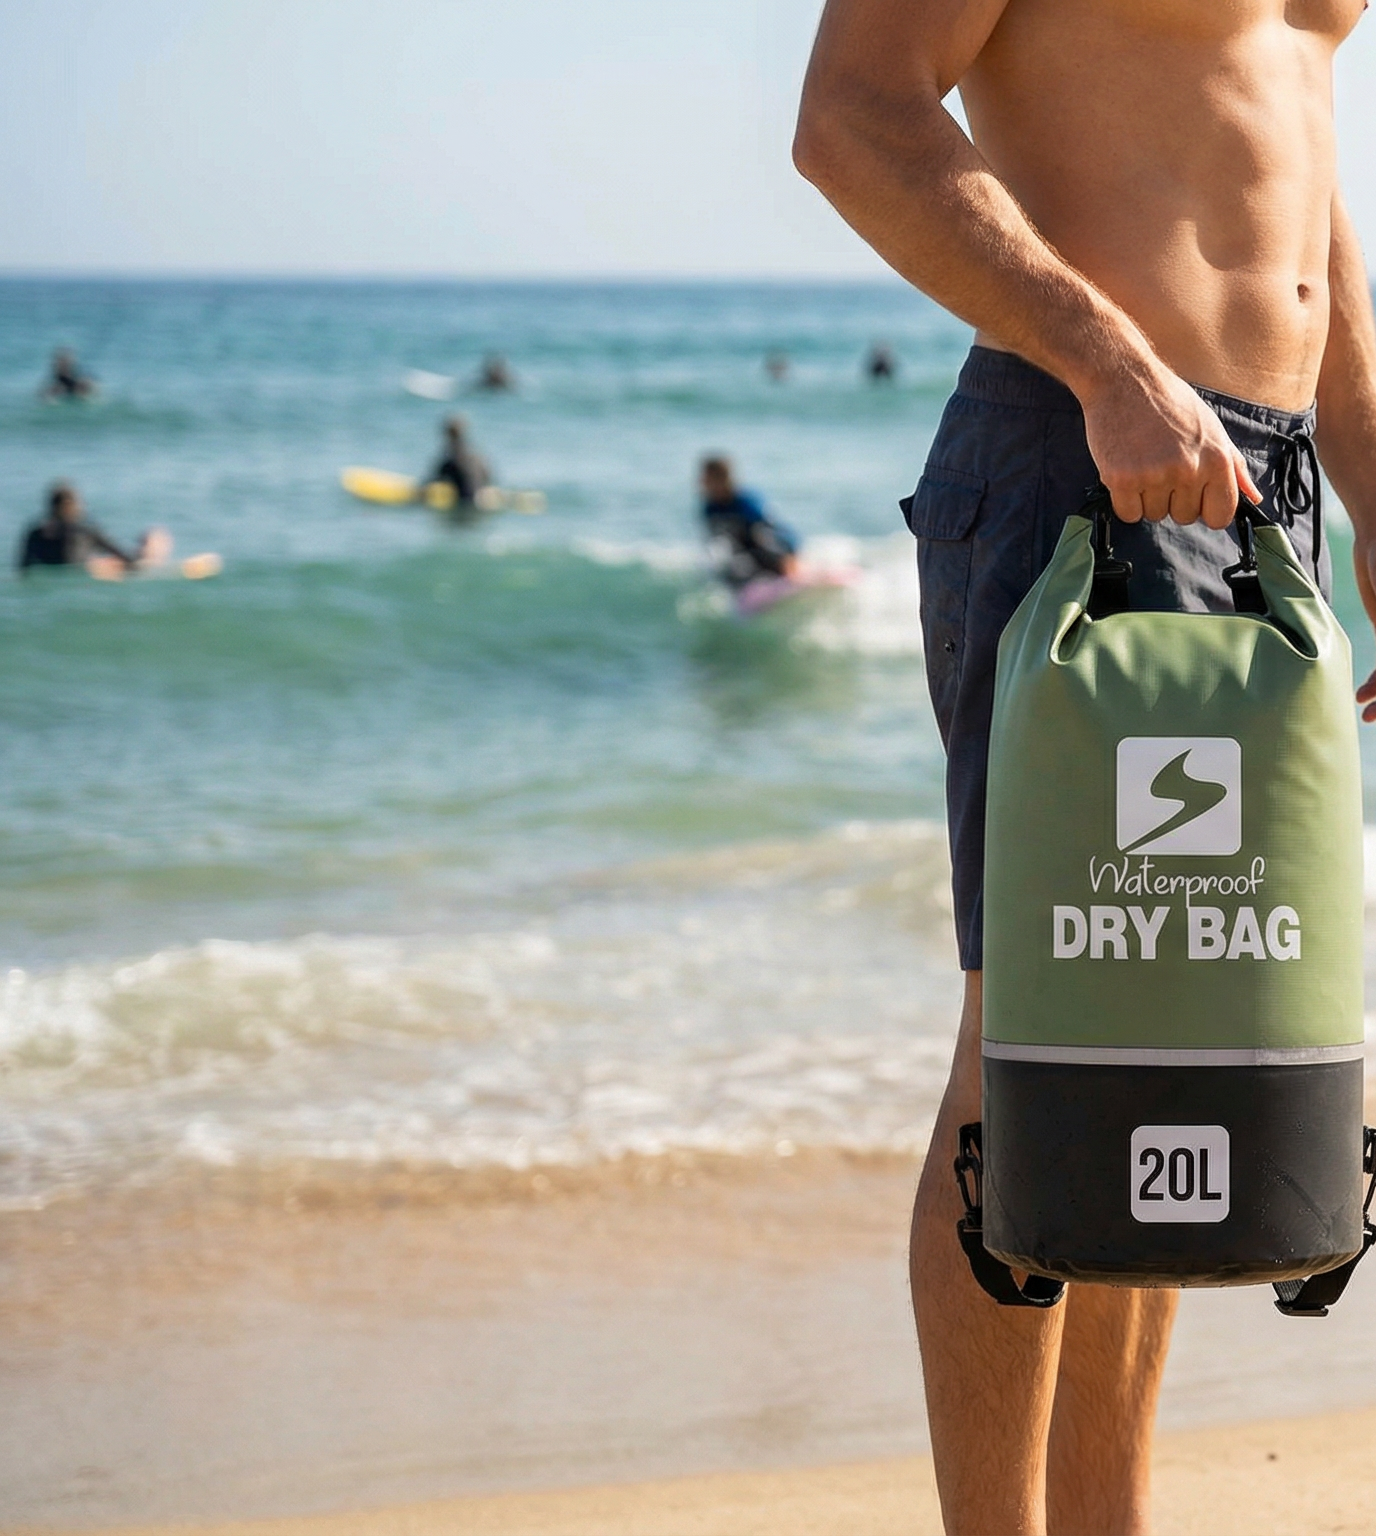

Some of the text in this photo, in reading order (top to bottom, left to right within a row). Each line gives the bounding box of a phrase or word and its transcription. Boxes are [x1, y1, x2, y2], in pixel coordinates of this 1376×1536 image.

[1089, 855, 1265, 908] Waterproof
[1053, 905, 1302, 962] DRY BAG
[1138, 1147, 1222, 1202] 20L
